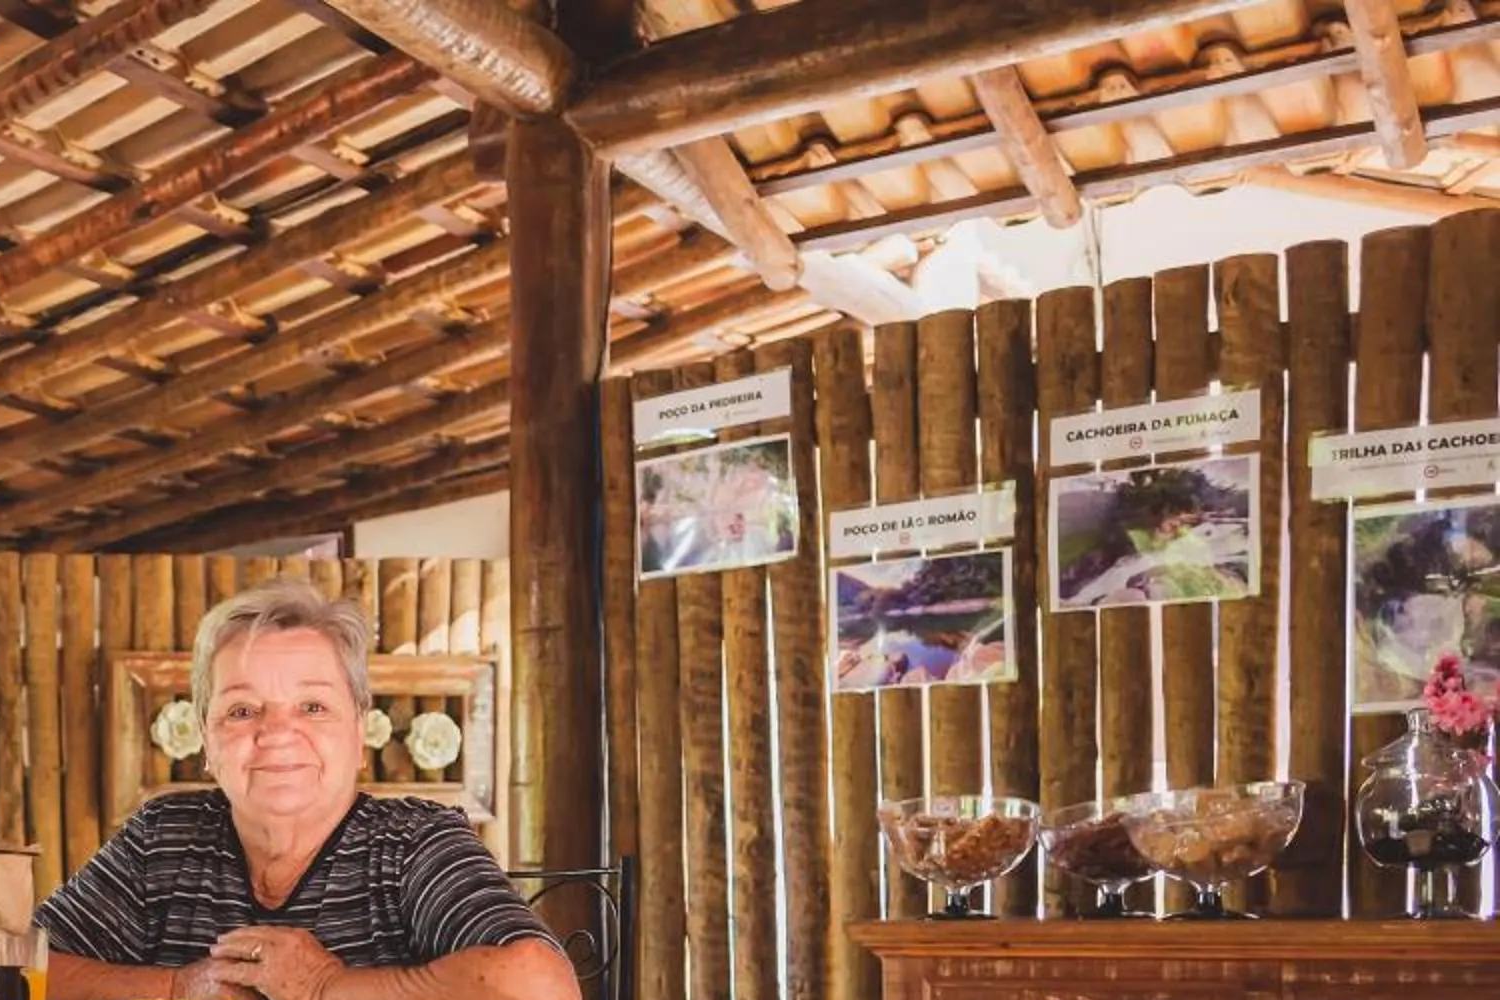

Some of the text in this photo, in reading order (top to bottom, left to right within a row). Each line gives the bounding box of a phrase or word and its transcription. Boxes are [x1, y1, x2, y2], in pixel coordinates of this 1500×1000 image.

[1066, 423, 1147, 443] CACHOEIRA
[1151, 417, 1171, 431] DA
[1176, 408, 1240, 427] FUMAÇA
[1427, 432, 1500, 451] CACHOE
